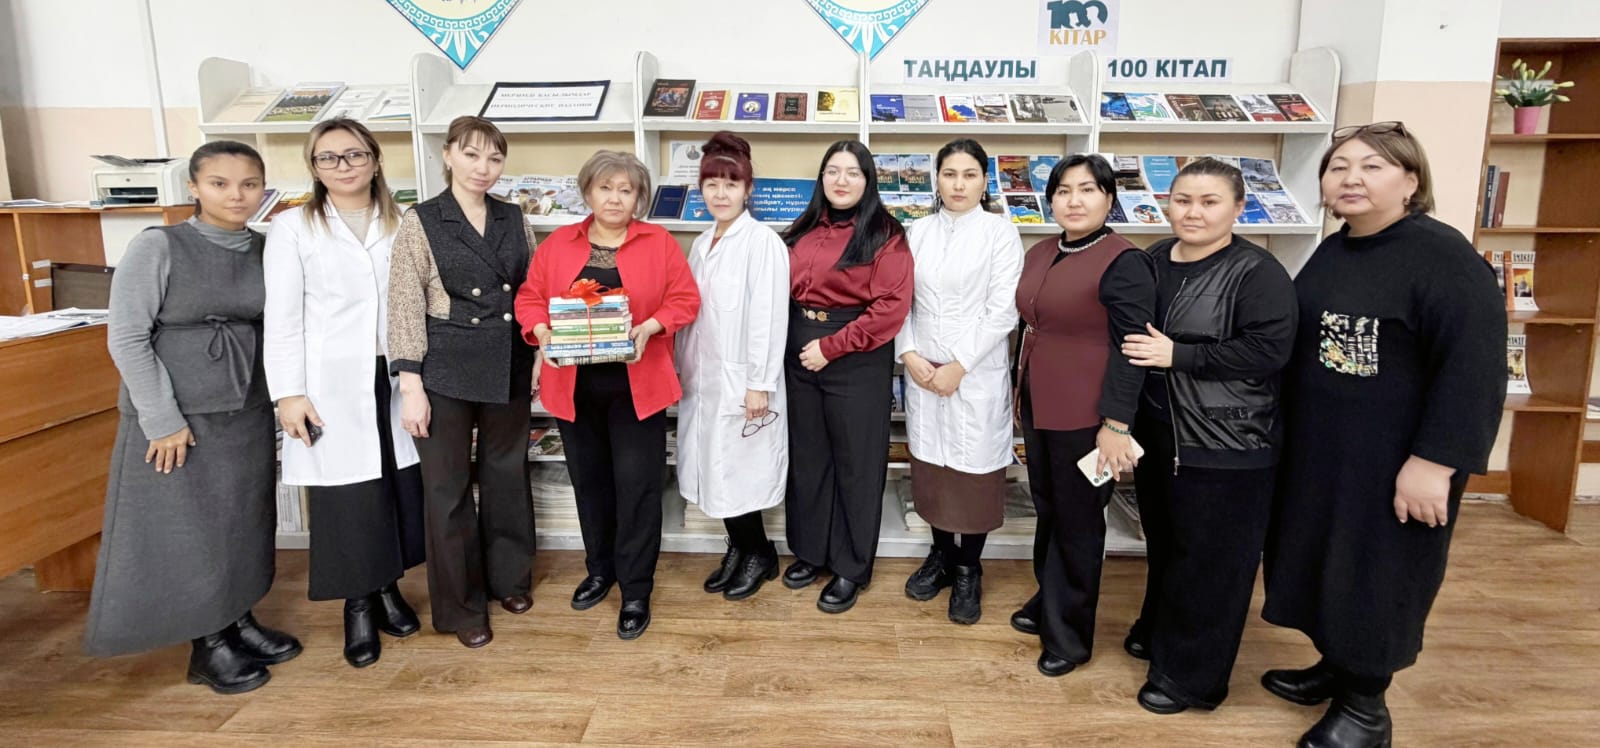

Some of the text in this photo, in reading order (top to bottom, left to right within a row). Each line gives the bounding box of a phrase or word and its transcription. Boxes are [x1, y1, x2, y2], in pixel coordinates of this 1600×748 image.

[1048, 29, 1107, 45] KITAP
[904, 60, 1036, 81] ТАҢДАУЛЫ
[1107, 59, 1227, 78] 100 КІТАП
